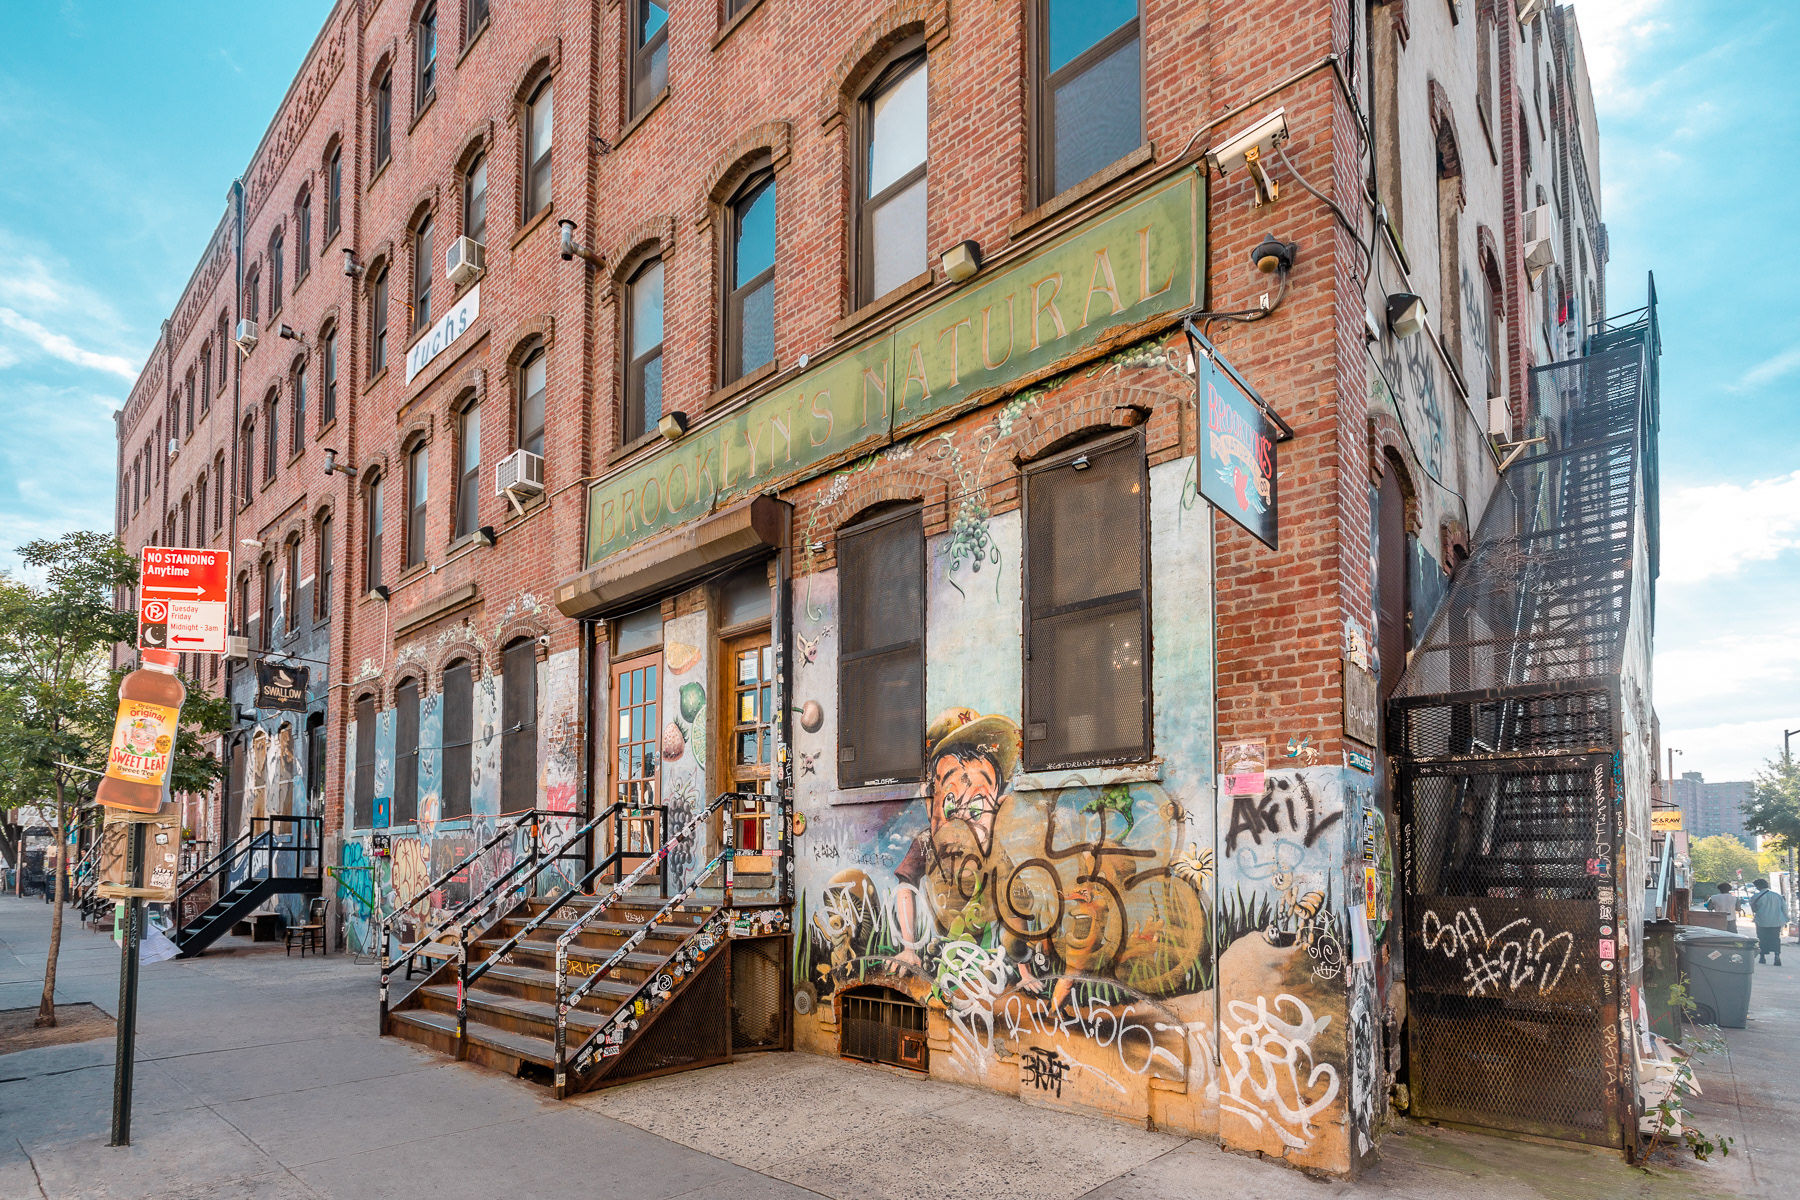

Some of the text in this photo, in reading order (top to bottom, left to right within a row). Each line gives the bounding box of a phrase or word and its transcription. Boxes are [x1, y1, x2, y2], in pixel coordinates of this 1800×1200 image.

[600, 388, 834, 547] BROOKLYN'S
[861, 223, 1177, 428] NATURAL
[1207, 381, 1272, 479] BROOKLYN'S
[147, 553, 215, 565] NO STANDING
[147, 565, 189, 577] Anytime
[172, 605, 198, 613] Tuesday
[171, 613, 191, 621] Friday
[170, 624, 198, 632] Midnight
[263, 685, 302, 699] SWALLOW
[130, 708, 166, 723] Original
[111, 746, 167, 771] SWEET LEAF
[117, 765, 155, 777] Sweet Tea
[1422, 906, 1532, 958] SAL
